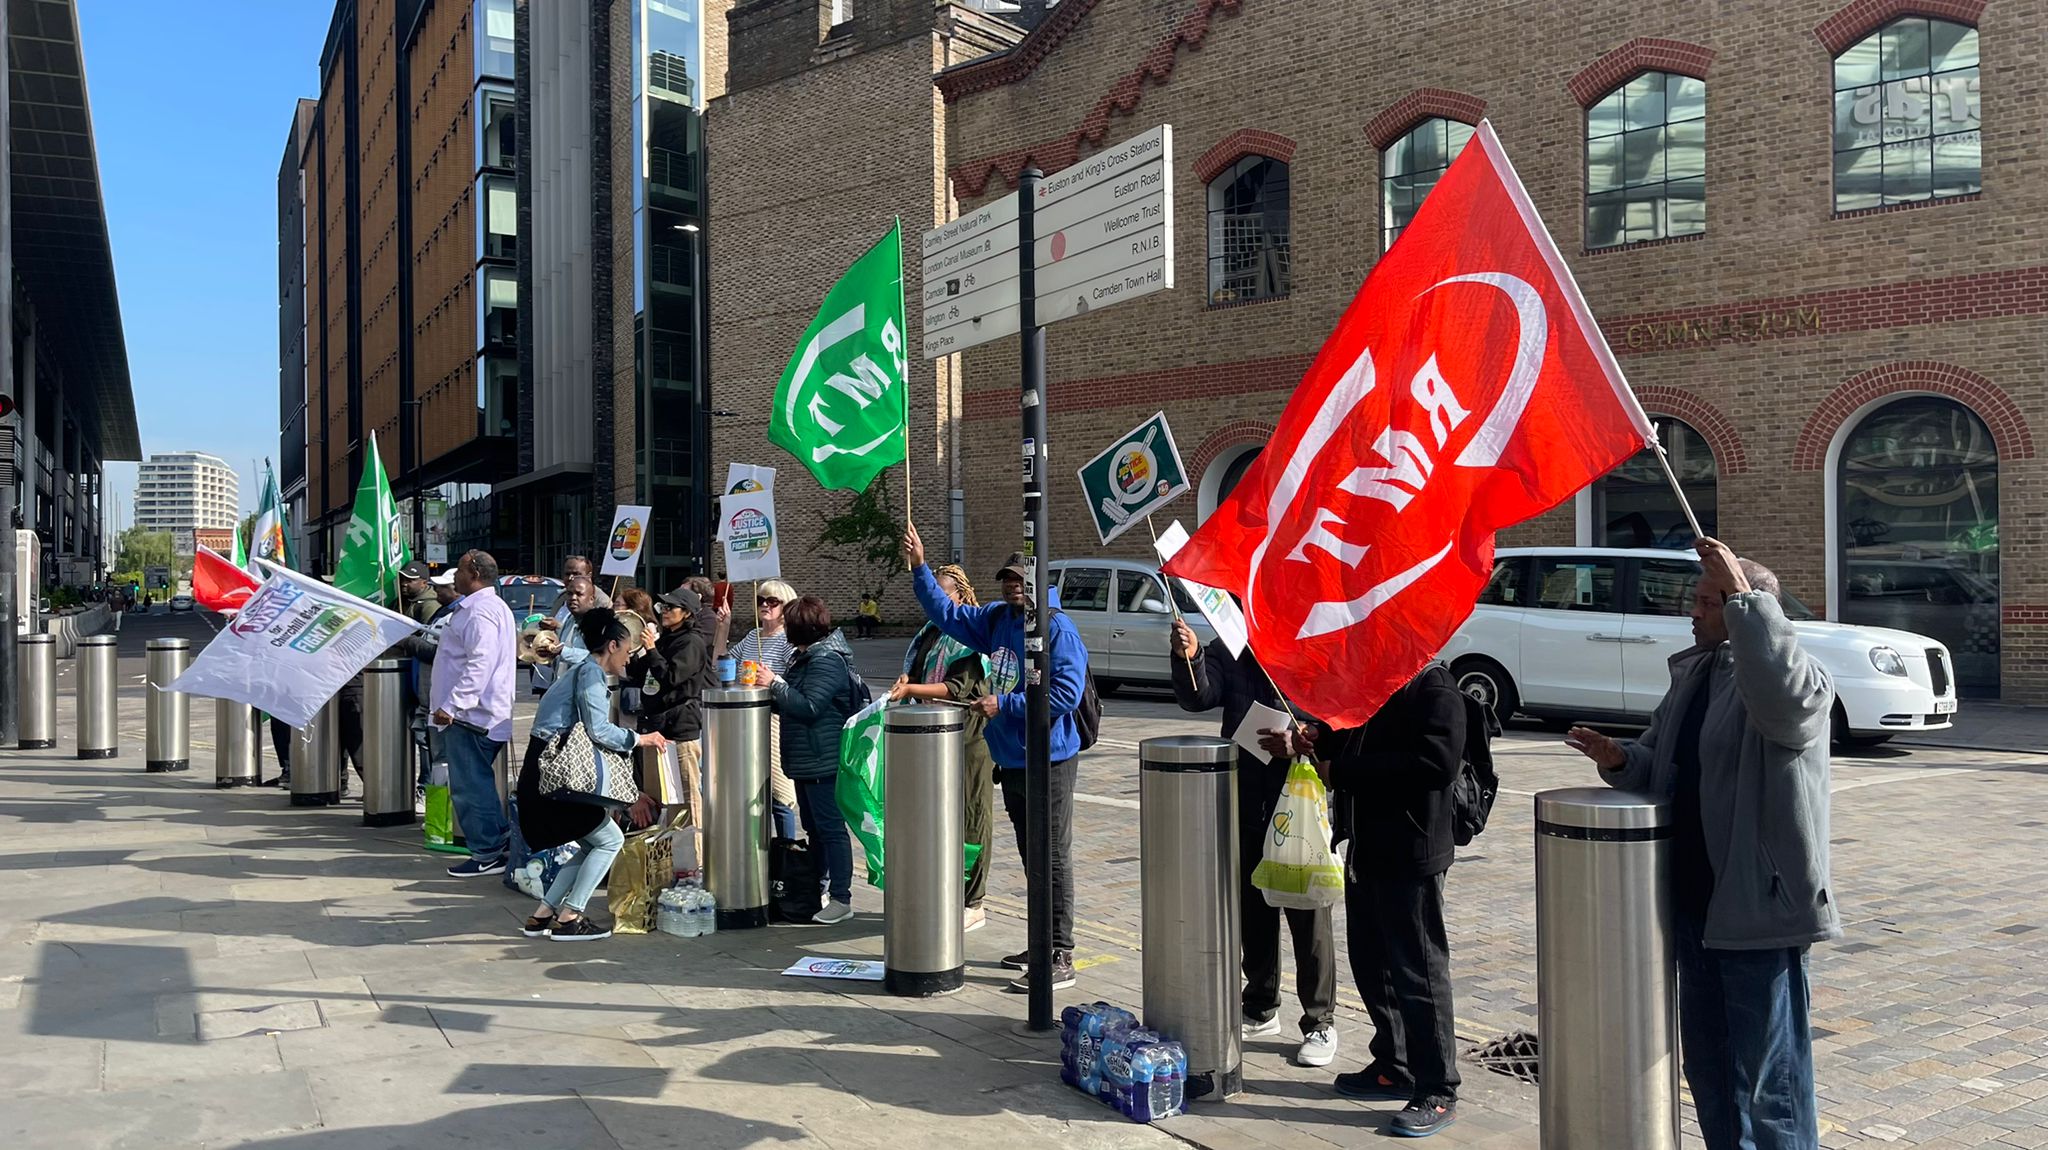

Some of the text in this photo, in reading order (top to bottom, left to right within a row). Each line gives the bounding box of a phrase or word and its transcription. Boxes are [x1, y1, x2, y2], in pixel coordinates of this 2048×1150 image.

[1048, 137, 1160, 194] Euston and King's Cross Stations
[1114, 169, 1161, 198] Euston Road
[924, 211, 992, 249] Camley Street Natural Park
[1103, 203, 1160, 233] Wellcome Trust
[925, 245, 983, 275] London Canal Museum
[925, 286, 946, 301] Camden
[1093, 267, 1162, 300] Camden Town Hall
[925, 313, 946, 326] Islington
[1627, 306, 1820, 349] GYMNASIUM
[925, 336, 955, 352] Kings Place
[735, 518, 765, 529] JUSTICE
[732, 541, 749, 550] FIGHT
[246, 582, 301, 632] JUSTICE
[268, 624, 283, 636] for
[270, 617, 306, 648] Churchill
[295, 623, 332, 653] FIGHT
[325, 615, 346, 631] FOR
